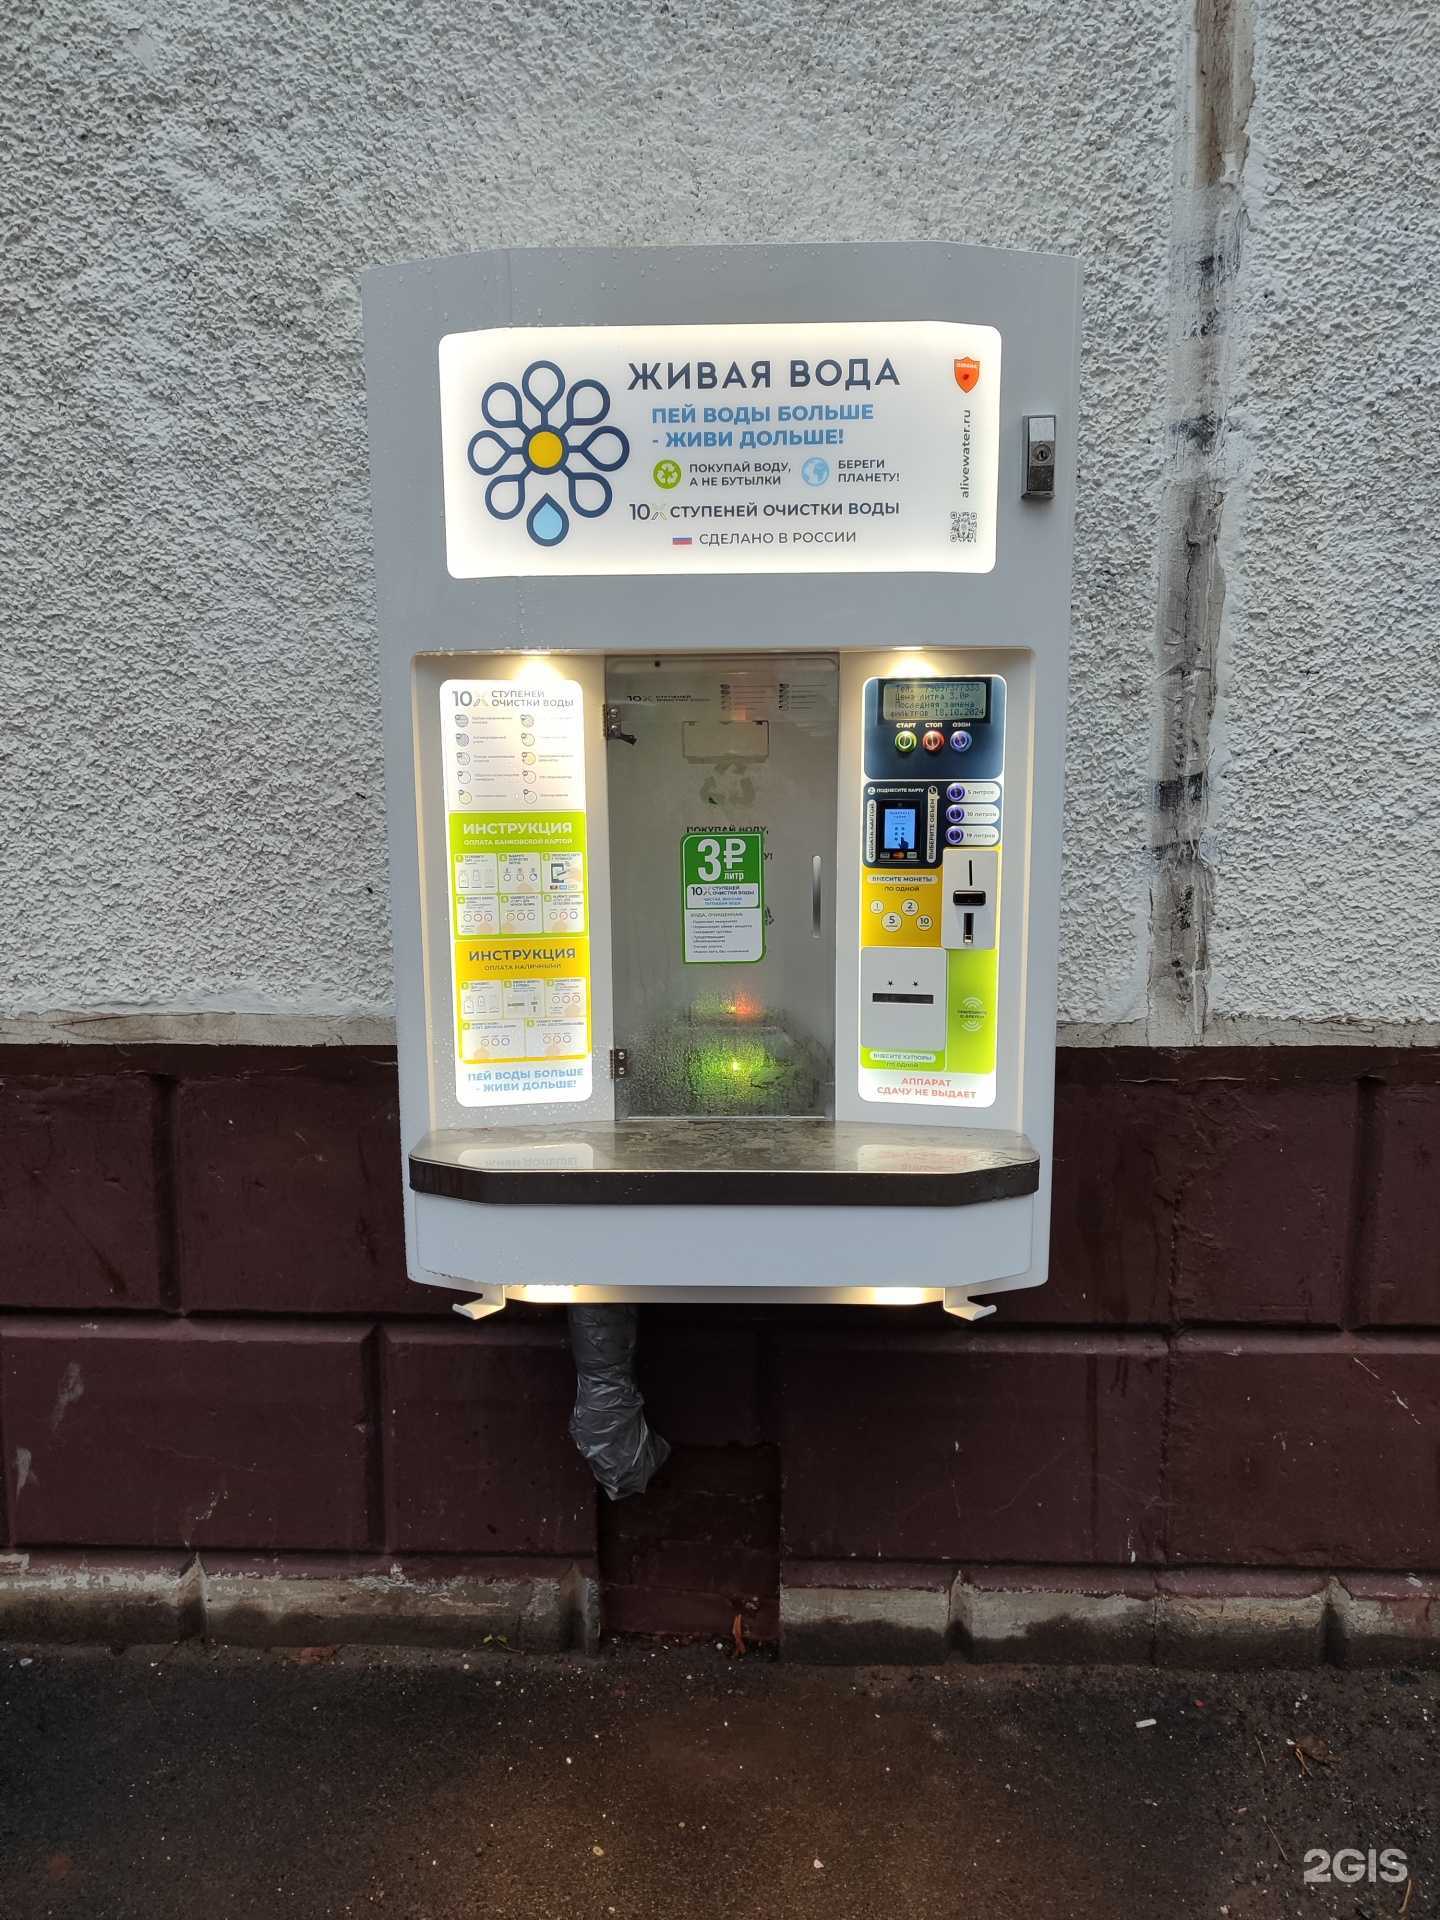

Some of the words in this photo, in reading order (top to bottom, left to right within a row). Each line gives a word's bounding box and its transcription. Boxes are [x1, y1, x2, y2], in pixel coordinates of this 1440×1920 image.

[627, 358, 773, 390] ЖИВАЯ
[790, 357, 901, 390] ВОДА
[651, 404, 698, 424] ПЕЙ
[703, 404, 772, 424] ВОДЫ
[778, 403, 875, 422] БОЛЬШЕ
[665, 430, 734, 448] ЖИВИ
[739, 428, 845, 449] ДОЛЬШЕ!
[961, 409, 972, 499] alivewater.ru
[689, 460, 750, 474] ПОКУПАЙ
[754, 460, 791, 476] ВОДУ,
[838, 459, 886, 471] БЕРЕГИ
[689, 476, 699, 487] А
[701, 476, 718, 487] НЕ
[721, 475, 782, 487] БУТЫЛКИ
[838, 471, 900, 485] ПЛАНЕТУ!
[670, 502, 759, 518] СТУПЕНЕЙ
[763, 502, 843, 517] ОЧИСТКИ
[848, 501, 900, 517] ВОДЫ
[699, 532, 774, 547] СДЕЛАНО
[778, 532, 788, 545] В
[792, 531, 857, 544] РОССИИ
[491, 690, 545, 699] СТУПЕНЕЙ
[491, 699, 540, 707] ОЧИСТКИ
[543, 699, 574, 708] ВОДЫ
[463, 822, 573, 836] ИНСТРУКЦИЯ
[724, 872, 744, 881] литр
[888, 915, 896, 924] 5
[920, 917, 930, 925] 10
[468, 948, 576, 962] ИНСТРУКЦИЯ
[468, 1070, 492, 1081] ПЕЙ
[495, 1069, 530, 1081] ВОДЫ
[535, 1067, 584, 1079] БОЛЬШЕ
[483, 1081, 519, 1092] ЖИВИ
[522, 1080, 577, 1092] ДОЛЬШЕ!
[901, 1077, 952, 1087] АППАРАТ
[877, 1087, 913, 1096] СДАЧУ
[931, 1090, 977, 1099] ВЫДАЕТ
